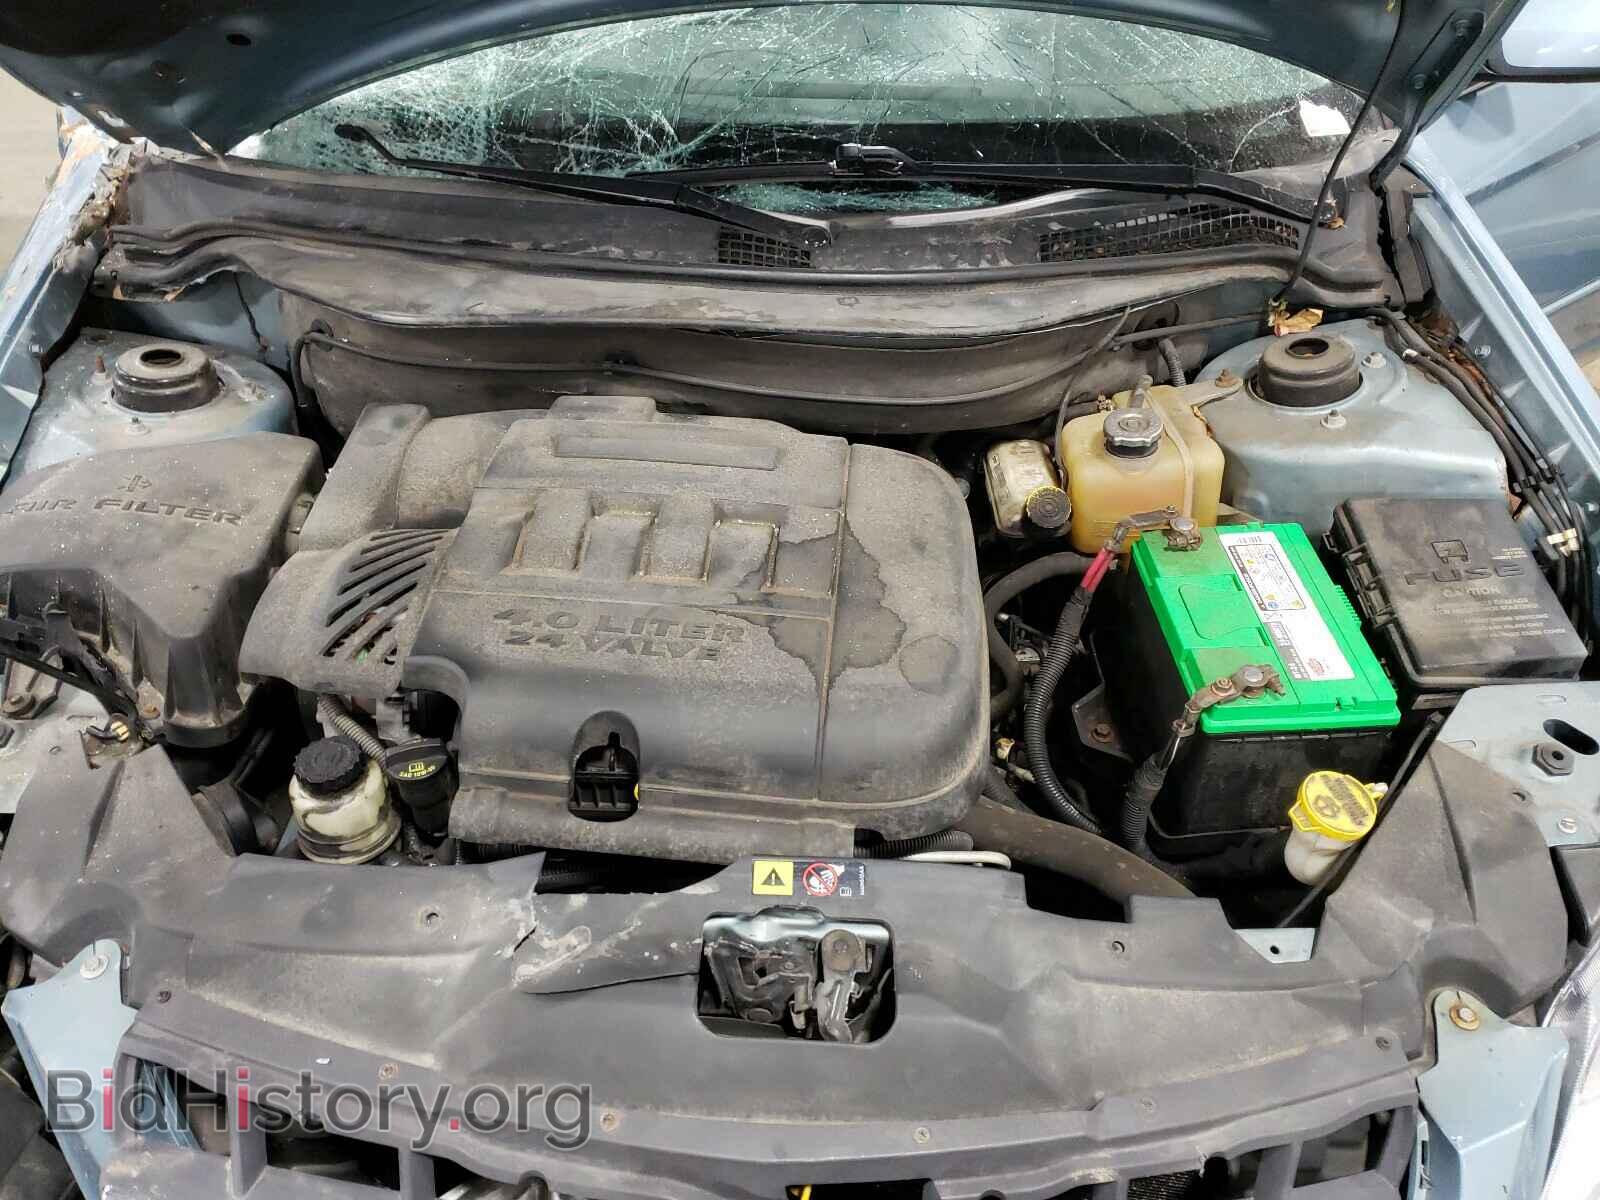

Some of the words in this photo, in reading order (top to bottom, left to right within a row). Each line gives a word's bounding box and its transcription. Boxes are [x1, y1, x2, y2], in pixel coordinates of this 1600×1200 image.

[95, 499, 241, 526] FILTER
[1404, 563, 1525, 586] FUSE
[1442, 585, 1500, 598] CATION
[493, 608, 579, 629] 4.0
[596, 613, 745, 643] LITER
[582, 634, 721, 663] VALVE
